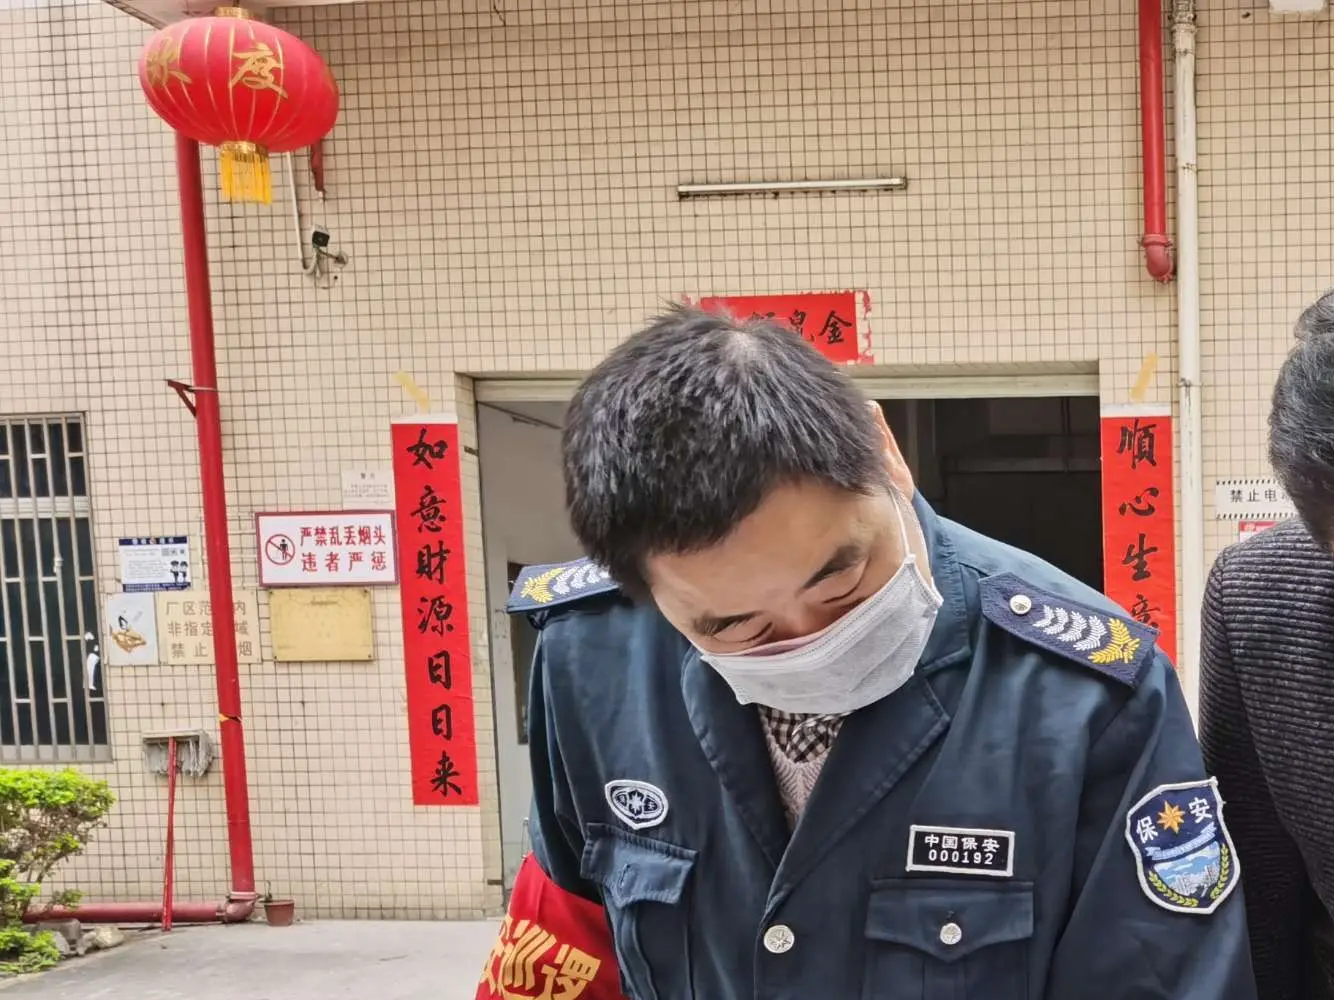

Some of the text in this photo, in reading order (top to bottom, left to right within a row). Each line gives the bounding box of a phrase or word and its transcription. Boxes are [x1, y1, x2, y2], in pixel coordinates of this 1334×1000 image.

[1230, 488, 1288, 503] 禁止电
[300, 525, 387, 547] 严禁乱丢烟头
[301, 551, 389, 573] 违者严惩
[165, 600, 247, 616] 厂区范内
[167, 620, 249, 637] 非指定域
[171, 641, 253, 659] 禁止烟
[1136, 797, 1213, 844] 保安
[924, 833, 1000, 853] 中国保安
[928, 849, 994, 865] 000192
